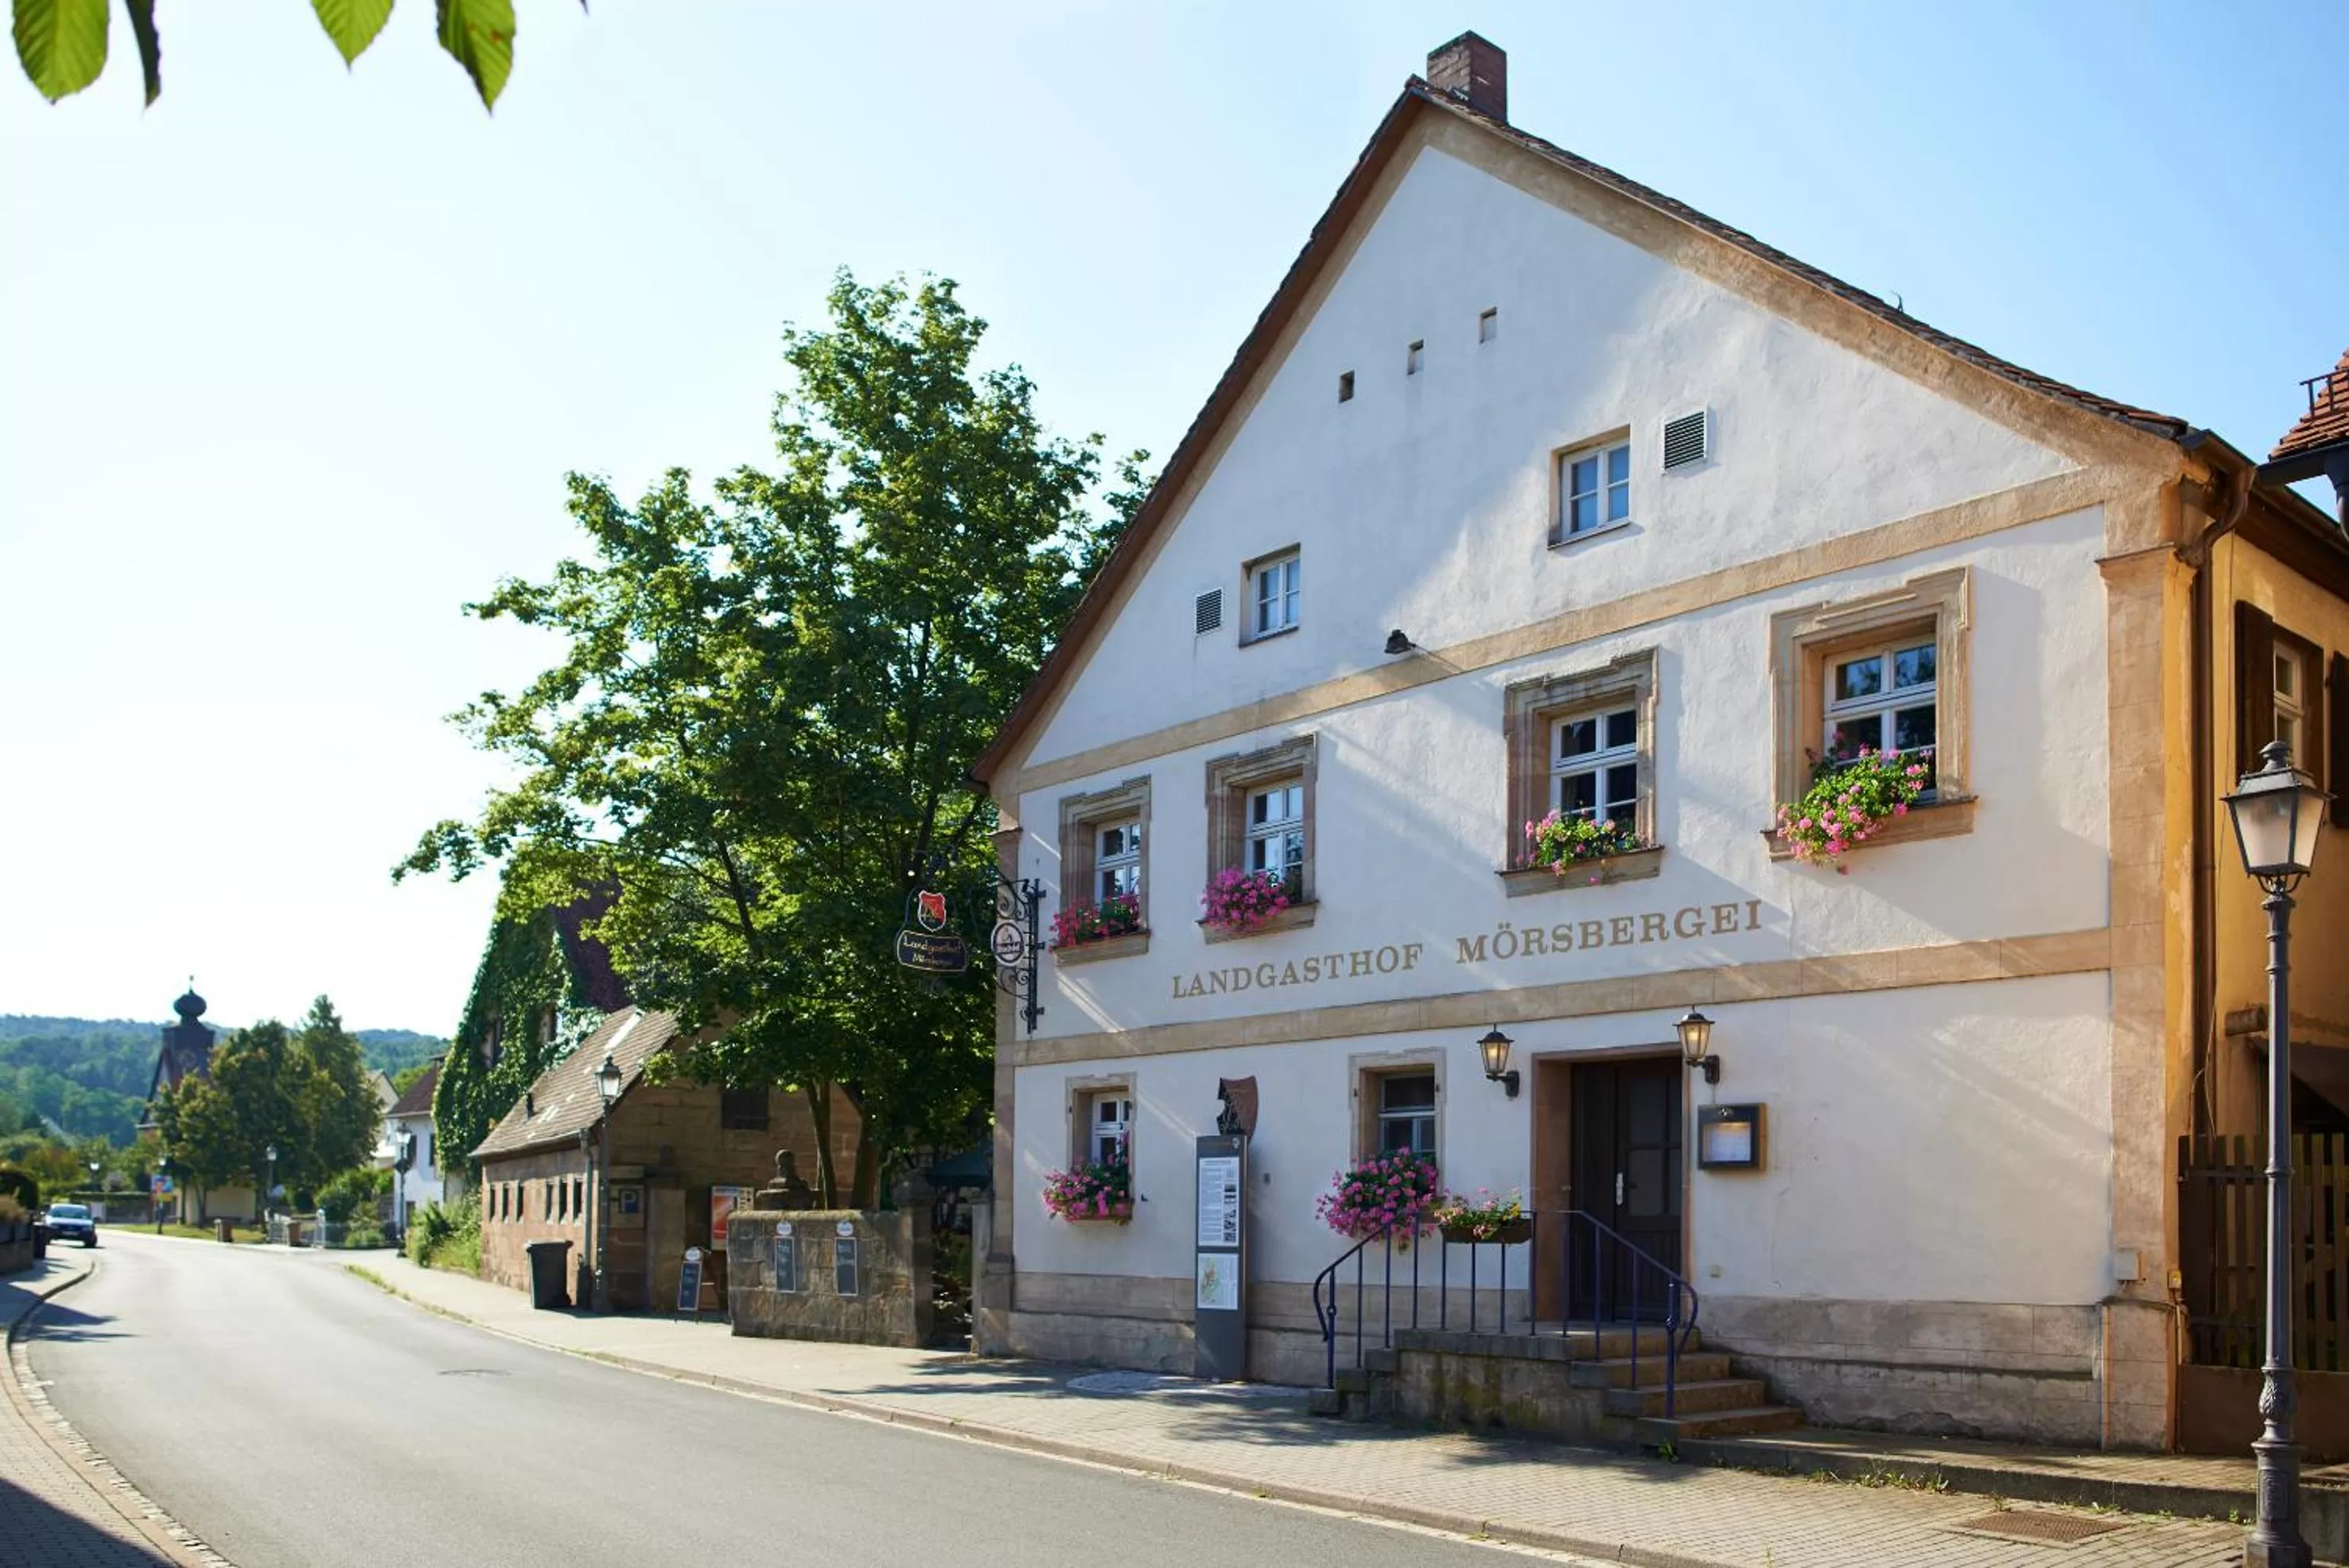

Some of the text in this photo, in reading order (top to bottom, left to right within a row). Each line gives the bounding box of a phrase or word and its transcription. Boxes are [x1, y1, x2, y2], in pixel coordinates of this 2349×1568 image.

[1172, 899, 1762, 999] LANDGASTHOF MÖRSBERGEI
[621, 1191, 636, 1213] P
